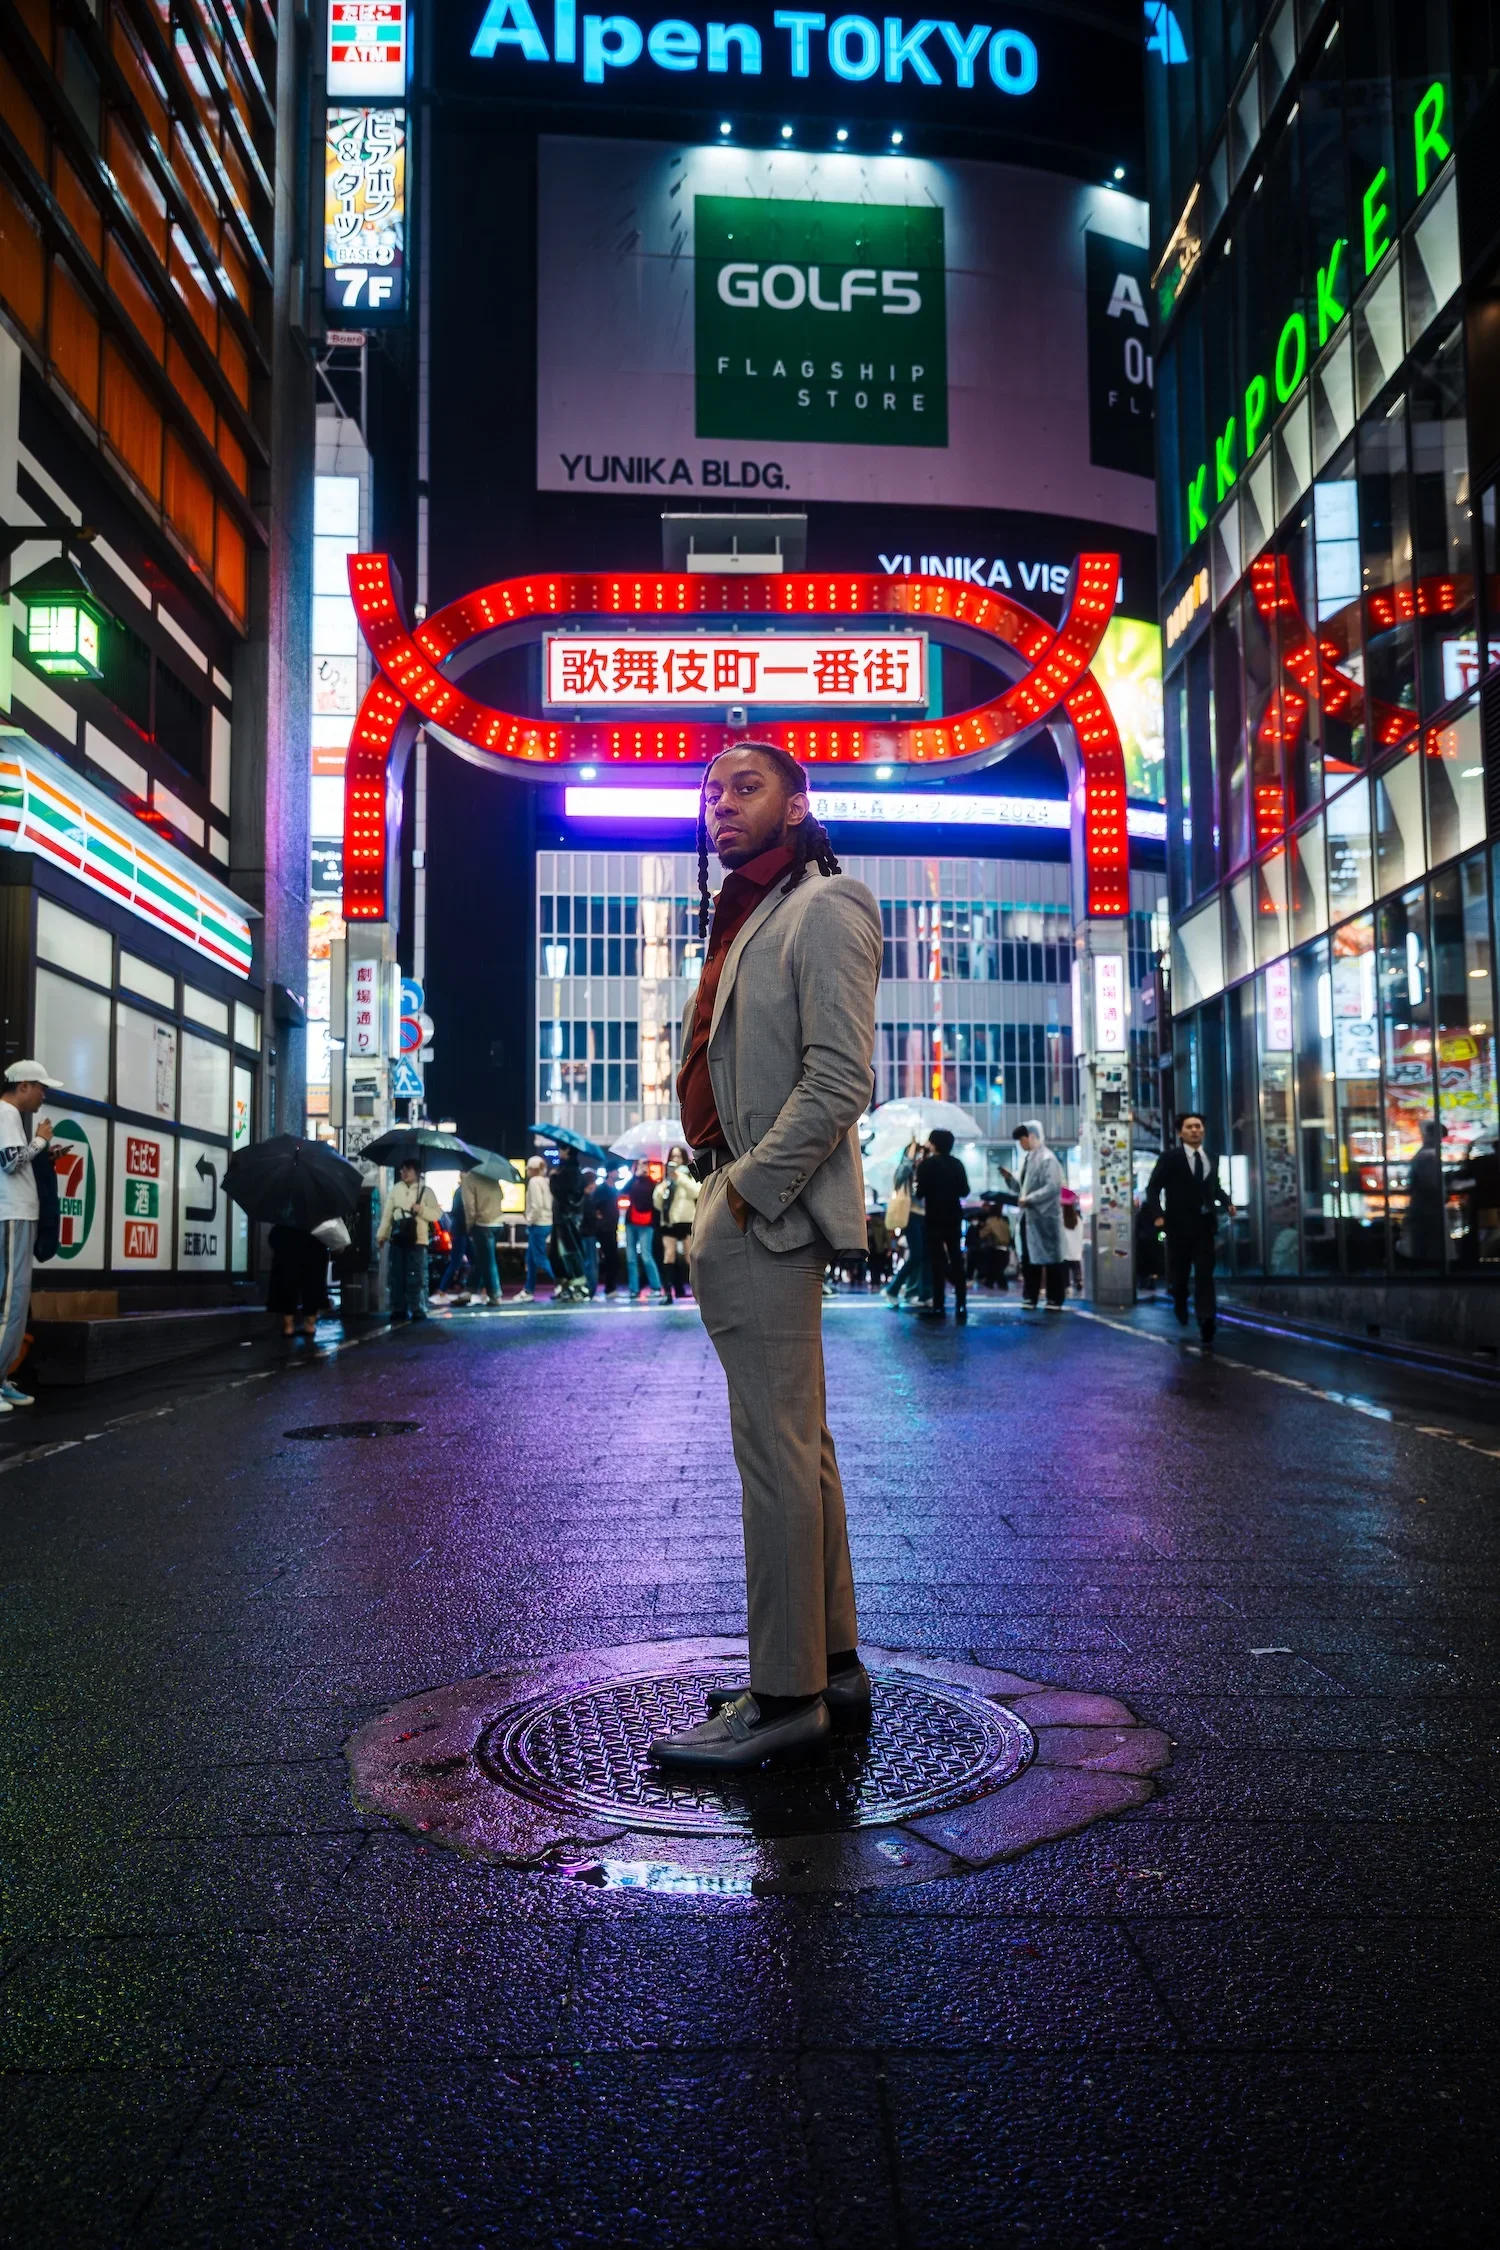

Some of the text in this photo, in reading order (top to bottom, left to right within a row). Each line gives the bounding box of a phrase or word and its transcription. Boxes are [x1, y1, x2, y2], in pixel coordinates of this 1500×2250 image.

[343, 46, 388, 63] ATM
[470, 0, 1038, 96] Alpen TOKYO
[335, 269, 393, 307] 7F
[717, 264, 921, 314] GOLF5
[718, 358, 924, 381] FLAGSHIP
[798, 389, 925, 411] STORE
[560, 454, 790, 489] YUNIKA BLDG.
[562, 648, 909, 694] 歌舞伎町一番街
[356, 967, 372, 1047] 劇場通り
[130, 1141, 157, 1174] たばこ
[134, 1183, 149, 1214] 酒
[129, 1225, 154, 1254] ATM
[184, 1232, 217, 1256] 正面入口
